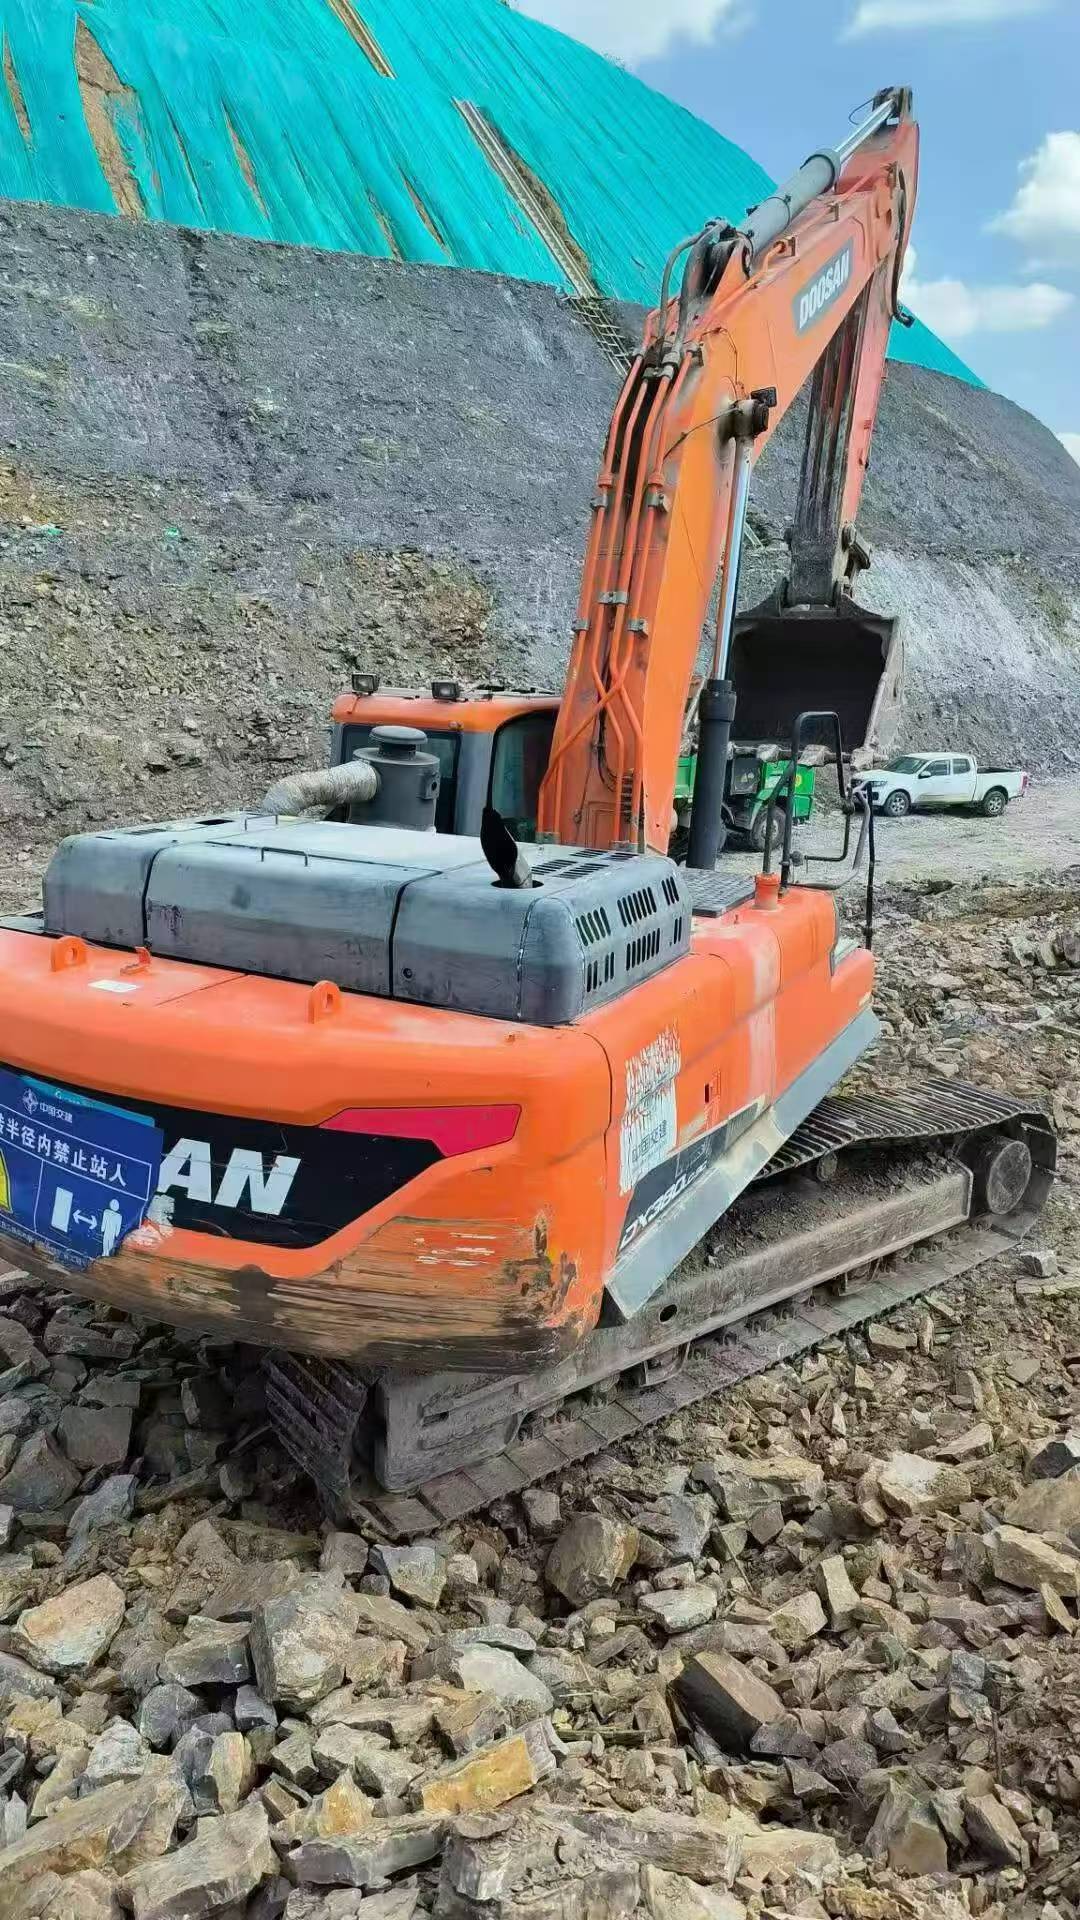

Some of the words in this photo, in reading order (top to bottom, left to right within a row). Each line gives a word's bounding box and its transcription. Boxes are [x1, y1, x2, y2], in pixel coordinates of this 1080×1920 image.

[799, 249, 849, 329] DOOSAN
[39, 1101, 73, 1124] 中国交建
